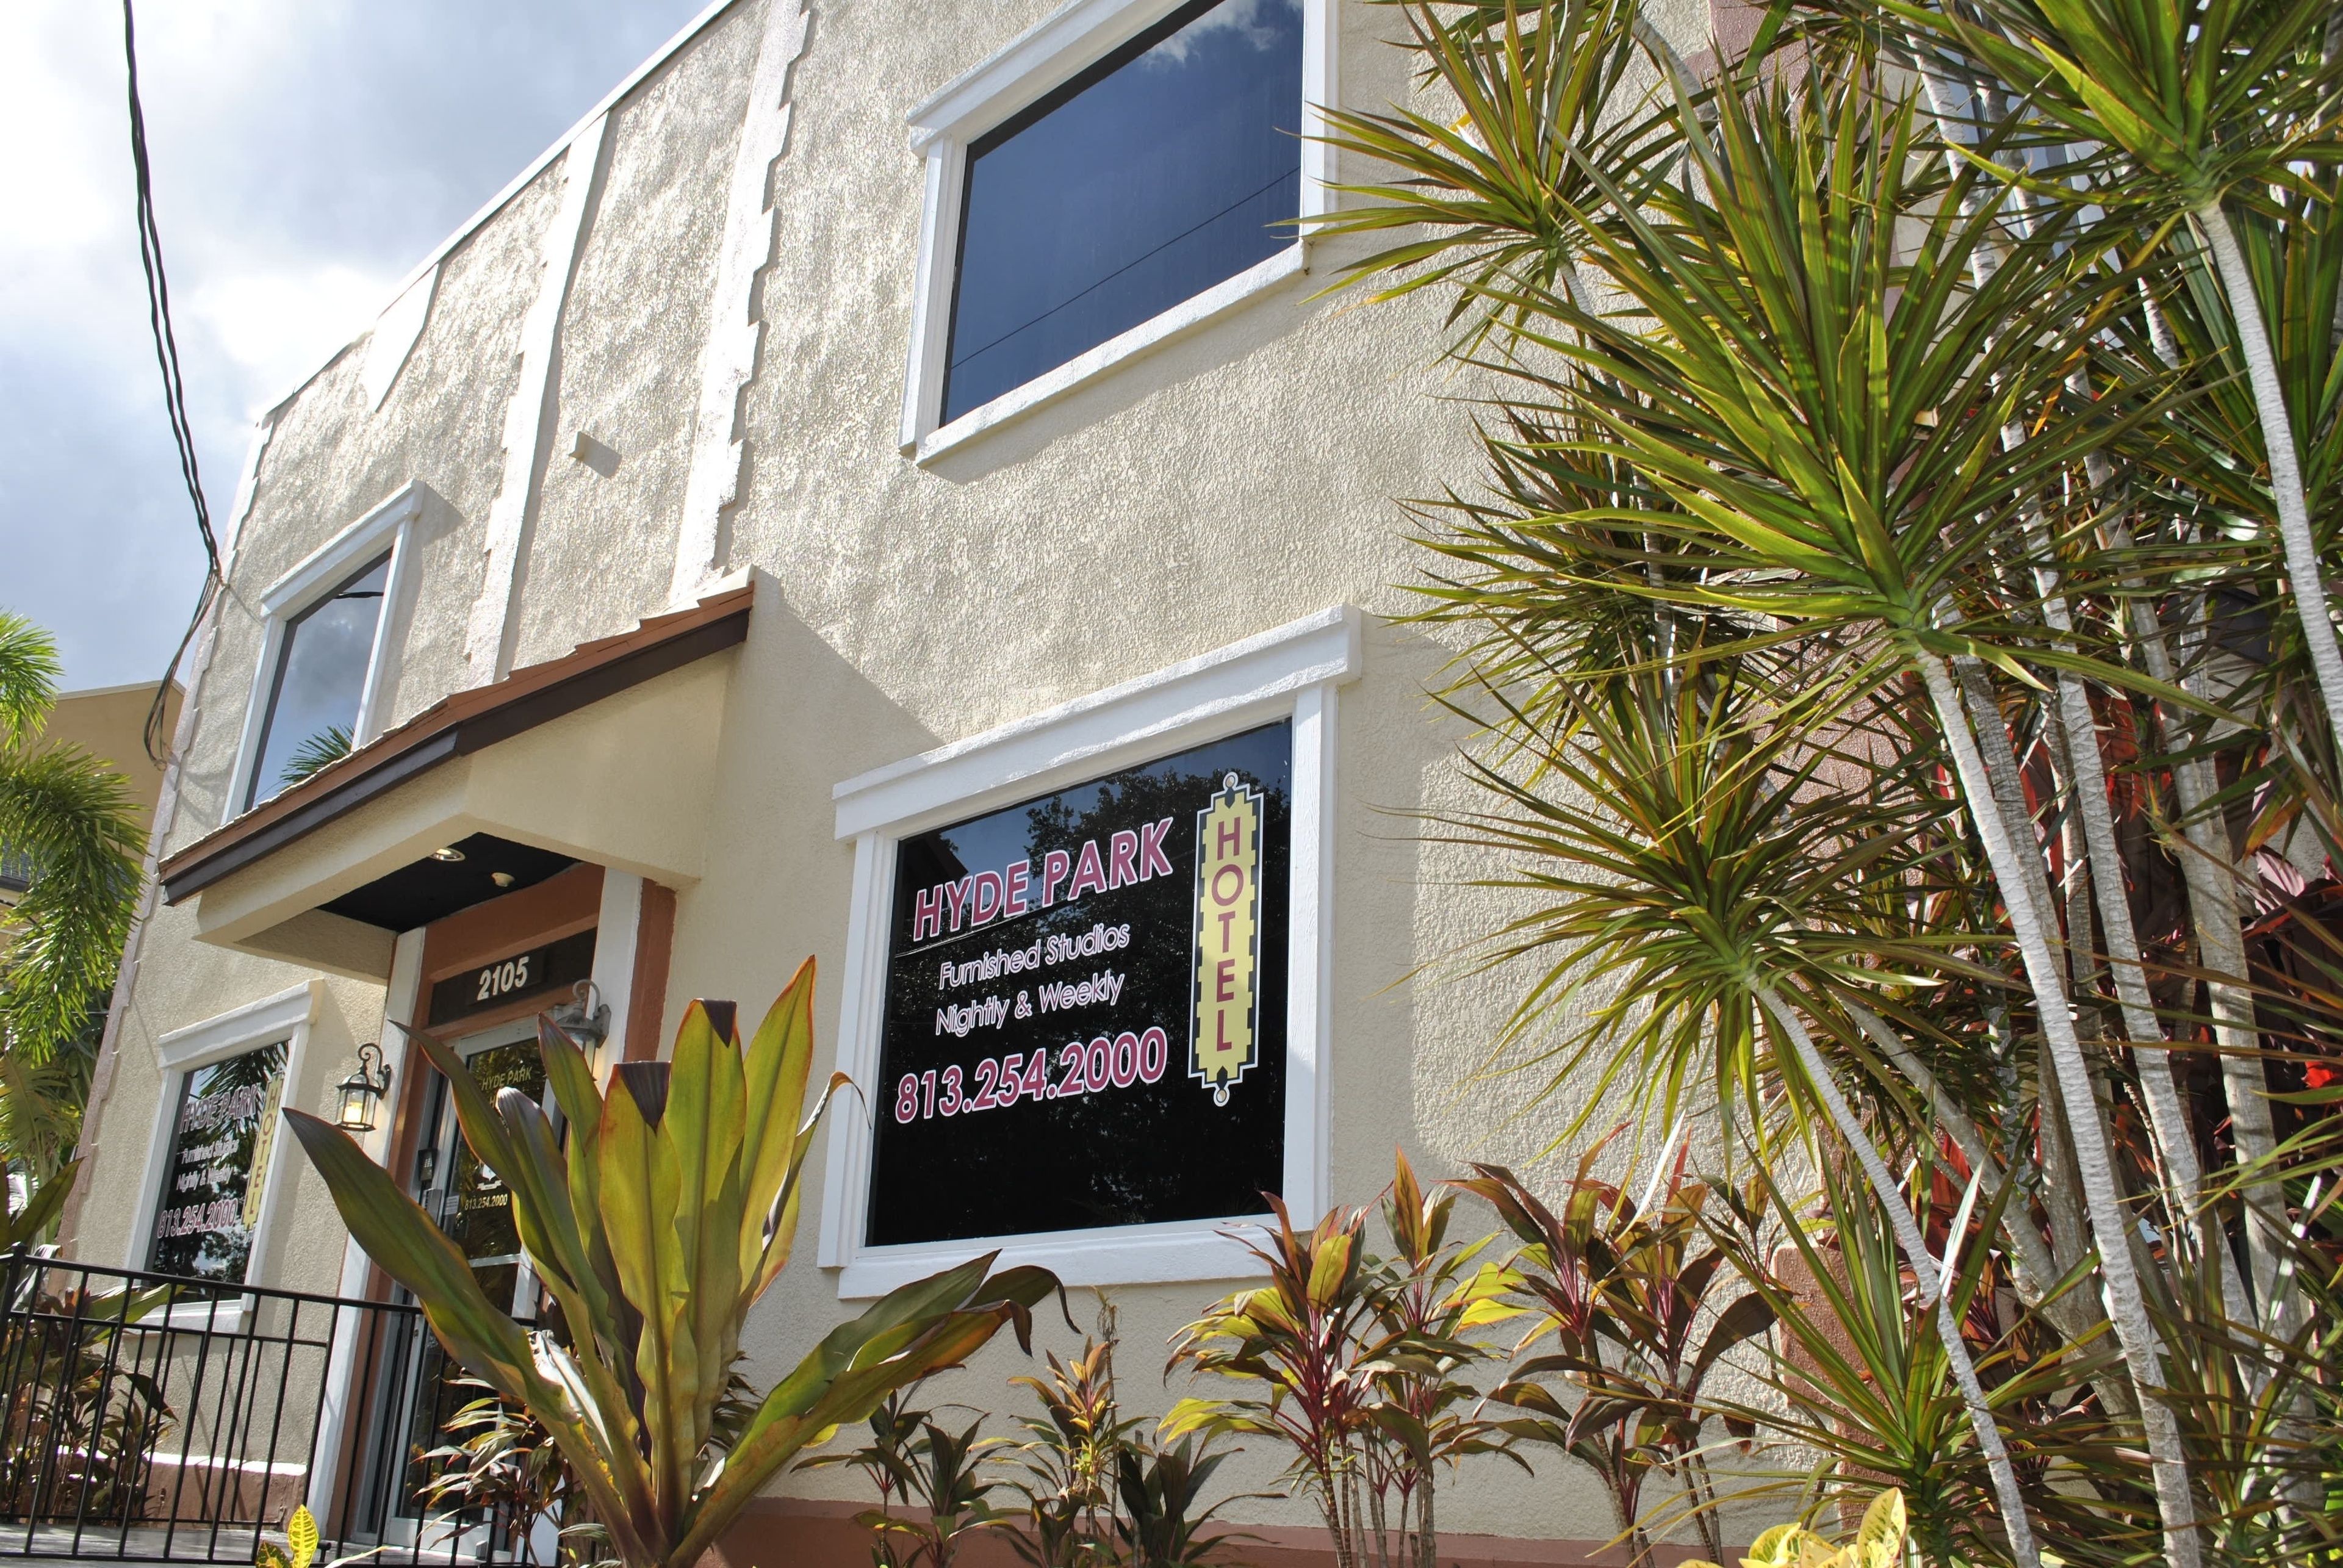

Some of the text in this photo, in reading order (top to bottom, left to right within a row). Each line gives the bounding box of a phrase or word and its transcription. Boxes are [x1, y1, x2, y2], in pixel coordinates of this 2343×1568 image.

[913, 816, 1173, 941] HYDE PARK
[938, 922, 1130, 990] Furnished Studios
[1211, 817, 1245, 1052] HOTEL
[477, 956, 530, 1001] 2105
[935, 970, 1125, 1037] Nightly & Weekly
[179, 1082, 261, 1134] HYDE PARK
[481, 1066, 533, 1091] HYDE PARK
[894, 1026, 1168, 1124] 813.254.2000
[250, 1088, 276, 1214] HOTEL
[157, 1198, 239, 1239] 813.254.2000
[465, 1193, 508, 1210] 813.254.2000
